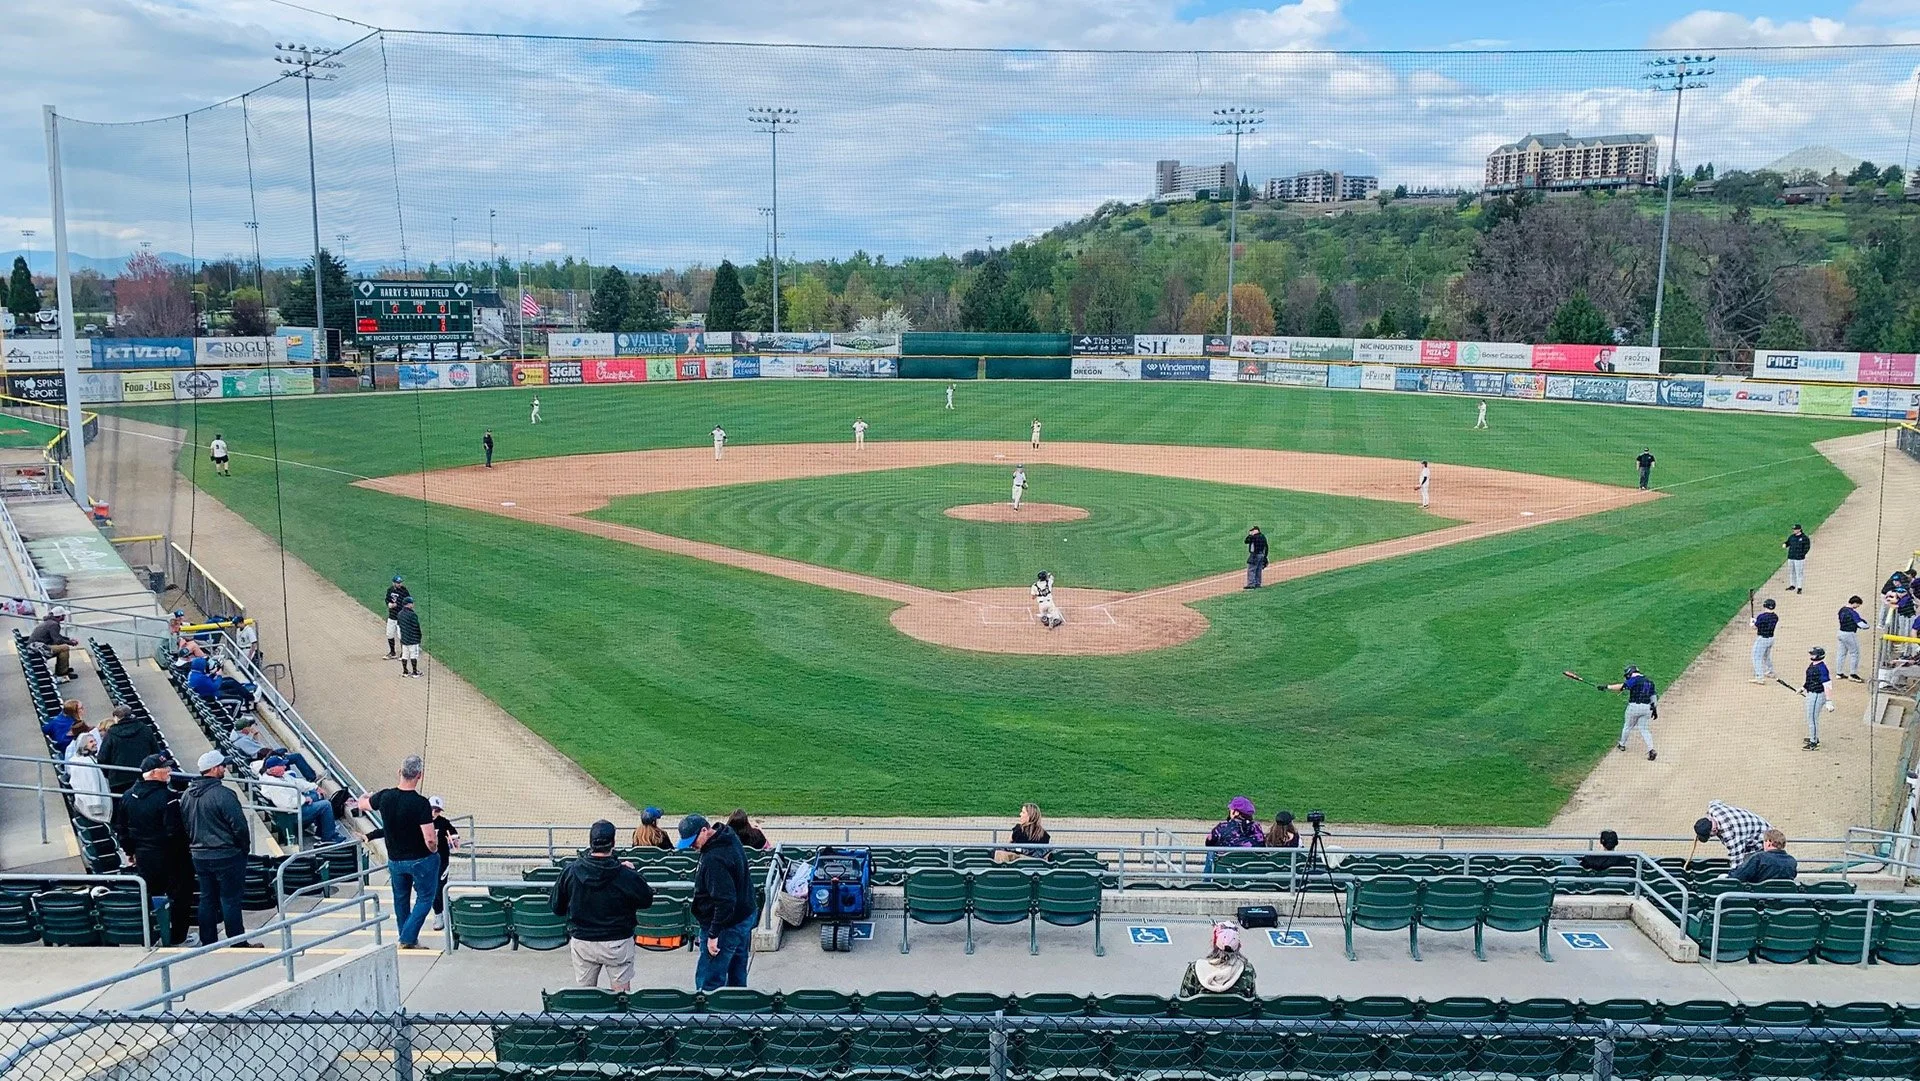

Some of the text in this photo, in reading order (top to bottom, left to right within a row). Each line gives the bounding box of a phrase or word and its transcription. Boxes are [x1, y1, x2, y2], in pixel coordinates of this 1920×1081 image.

[380, 288, 450, 297] HARRY & DAVID FIELD
[630, 333, 676, 347] VALLEY
[1093, 336, 1110, 345] The
[1110, 336, 1127, 345] Den
[224, 340, 275, 353] ROGUE
[618, 346, 658, 354] IMMEDIATE
[1373, 343, 1414, 351] INDUSTRIES
[106, 346, 157, 359] KTVL
[1624, 354, 1650, 362] FROZEN
[1767, 355, 1845, 371] PACE Supply
[681, 365, 700, 376] ALERT
[871, 359, 892, 374] 12
[1159, 363, 1206, 371] Windermere
[550, 366, 581, 378] SIGNS
[37, 379, 63, 388] SPINE
[124, 381, 144, 392] FOOD
[154, 380, 171, 391] LESS
[29, 389, 58, 399] SPORT
